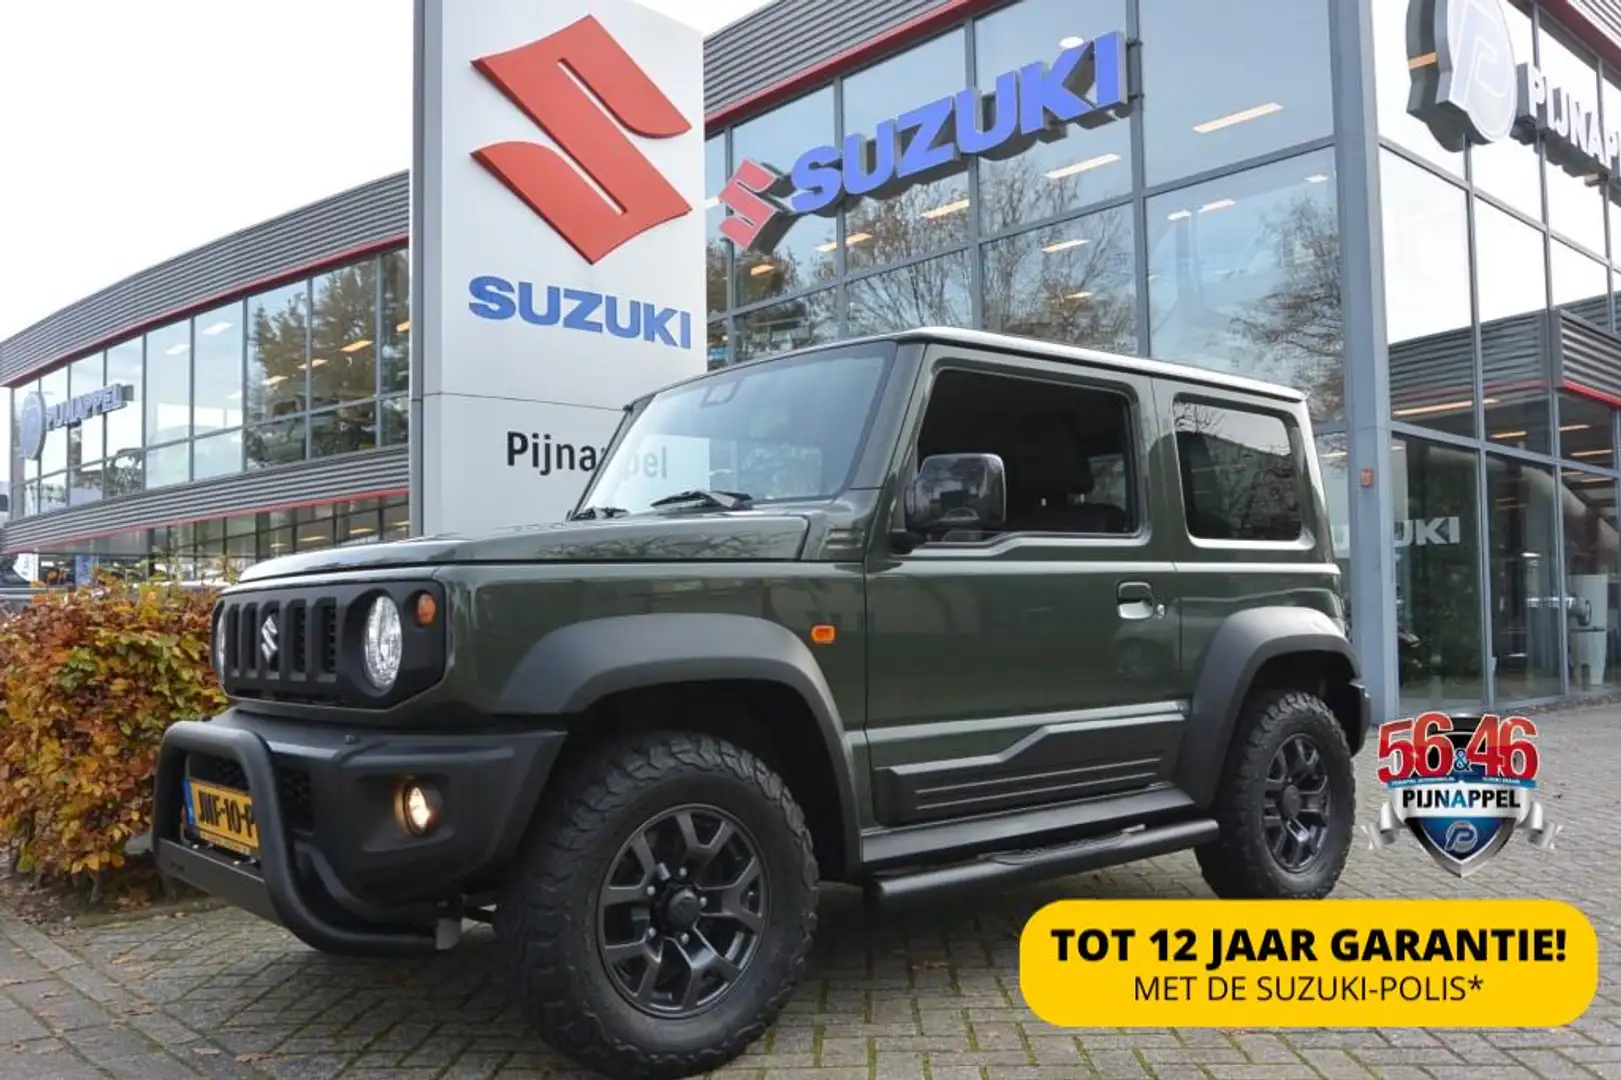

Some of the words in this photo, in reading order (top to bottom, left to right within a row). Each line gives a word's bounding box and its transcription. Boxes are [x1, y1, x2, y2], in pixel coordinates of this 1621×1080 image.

[791, 31, 1125, 214] SUZUKI
[1528, 62, 1621, 170] PIJNAP
[468, 275, 692, 350] SUZUKI
